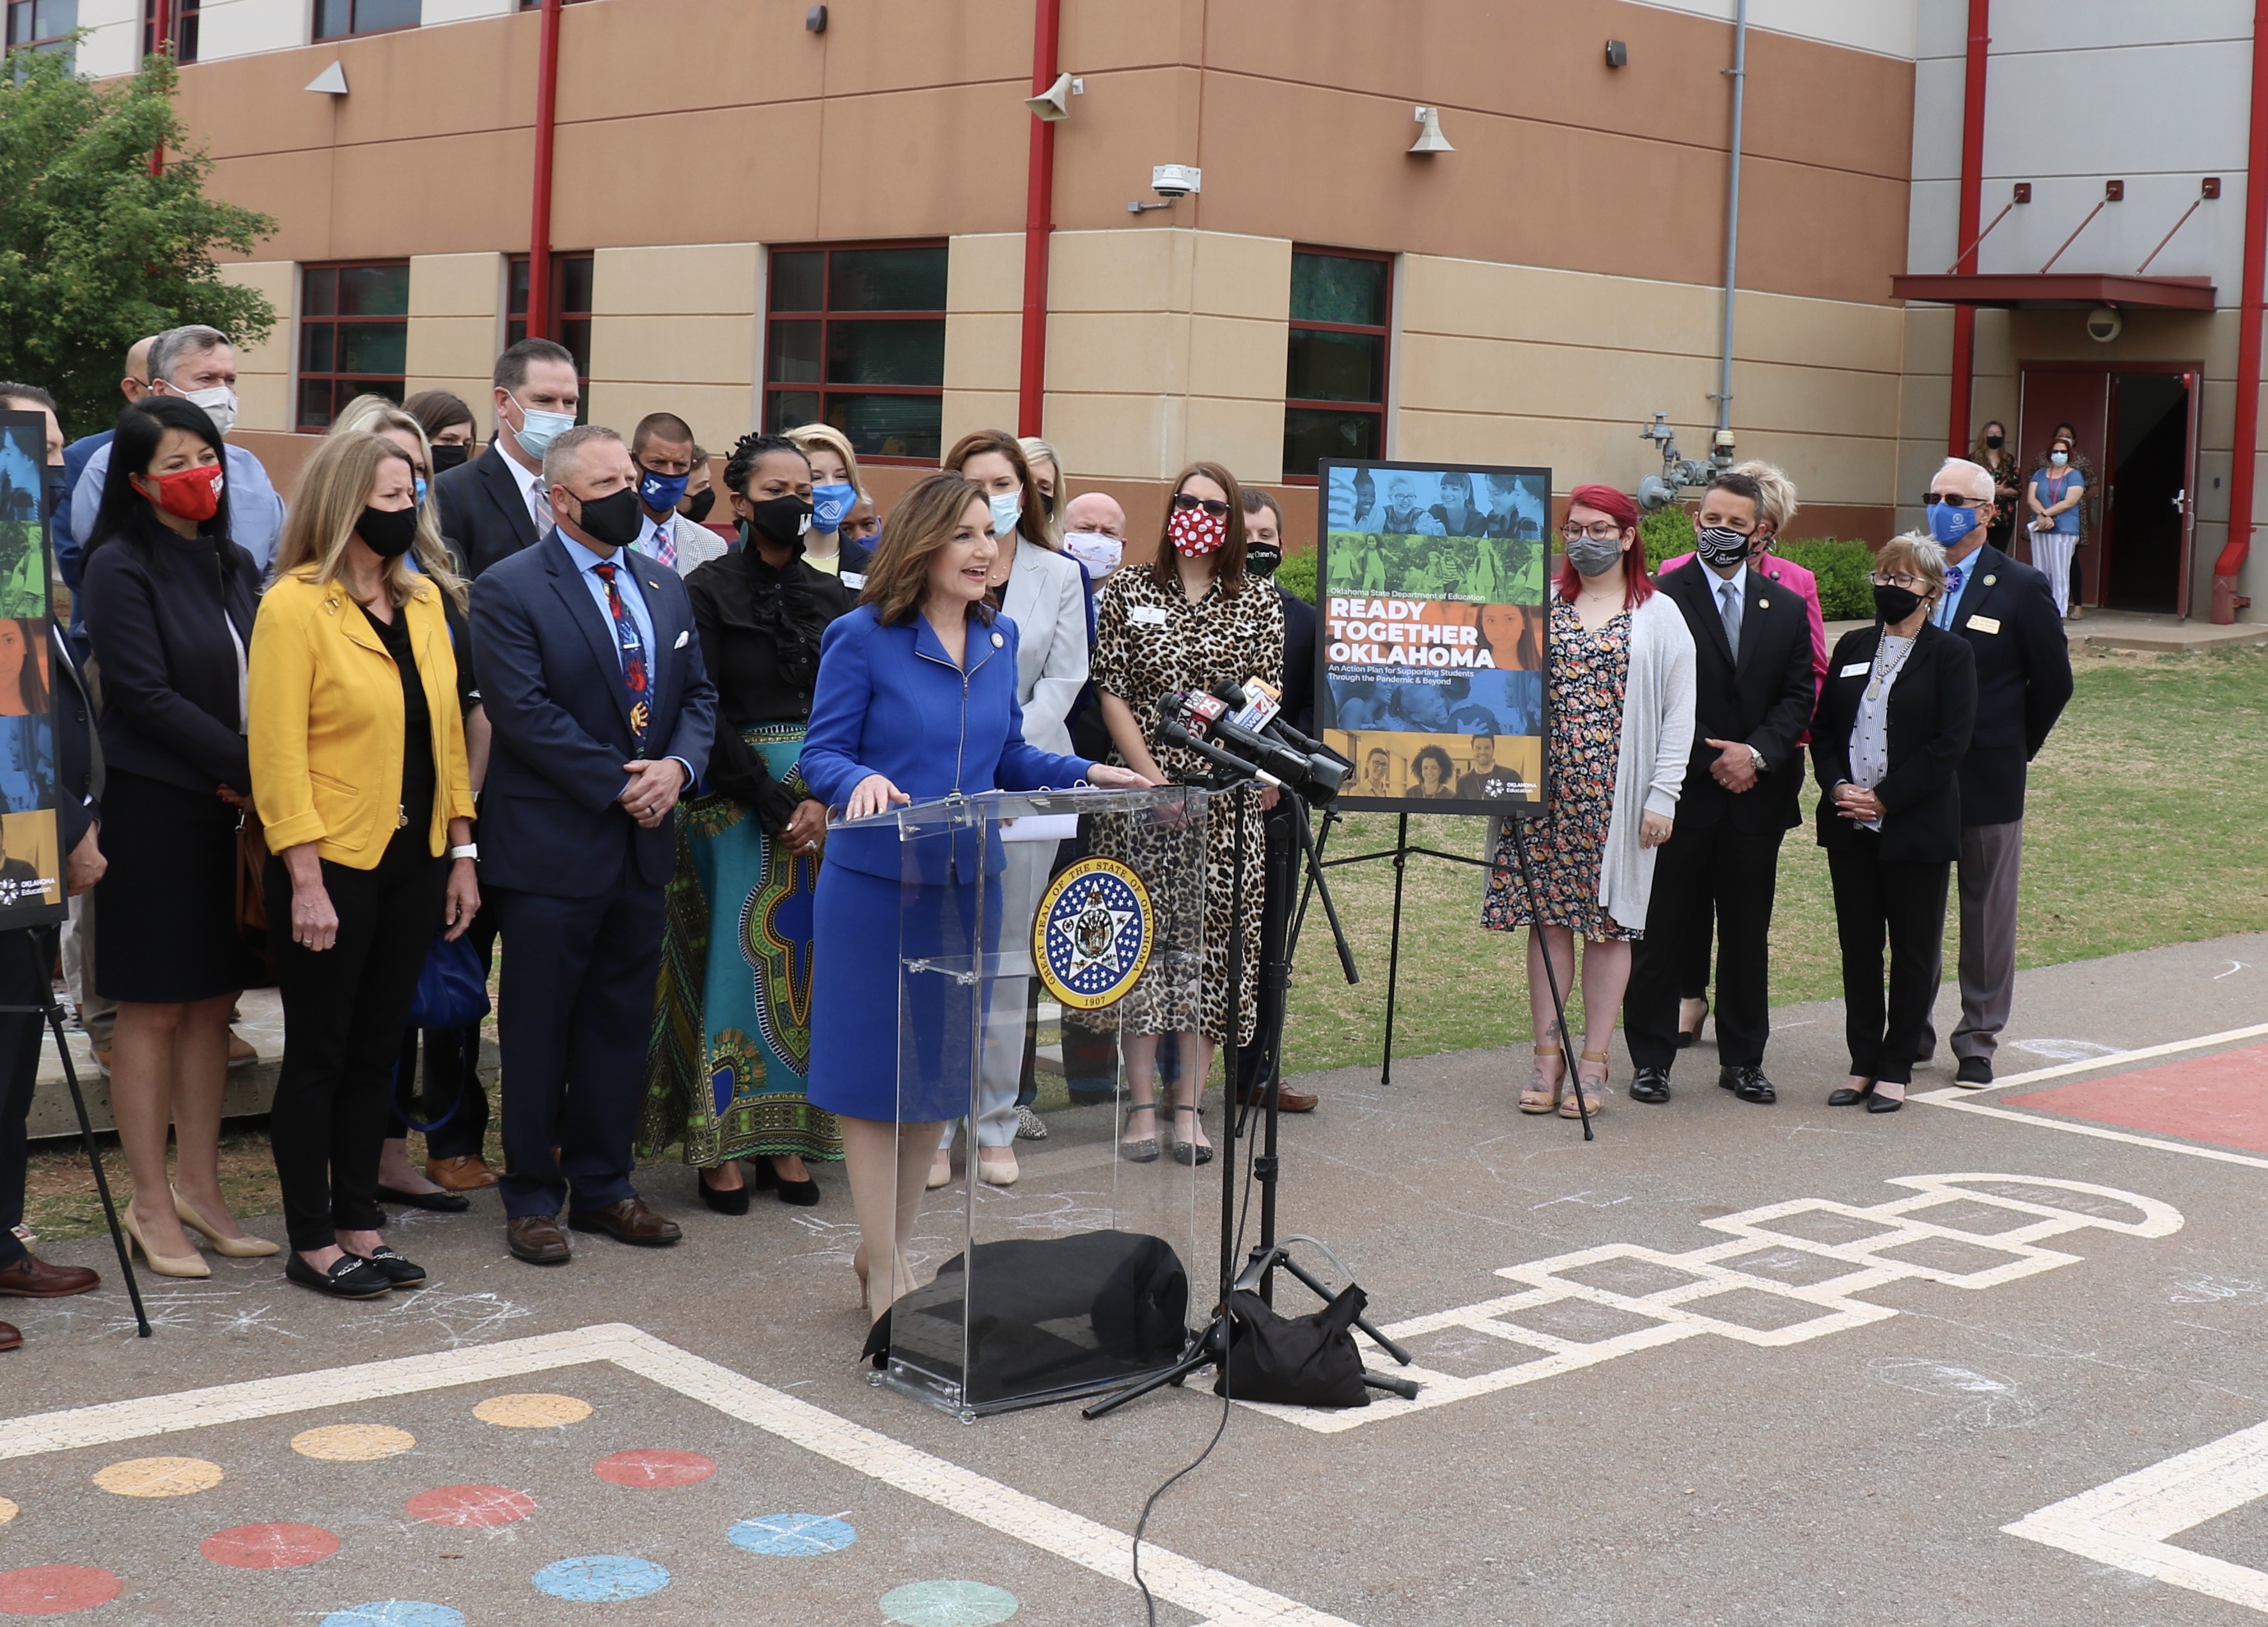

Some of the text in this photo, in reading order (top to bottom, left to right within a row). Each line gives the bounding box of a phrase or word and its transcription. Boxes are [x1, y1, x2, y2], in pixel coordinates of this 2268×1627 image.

[1331, 588, 1369, 596] Oklahoma
[1391, 590, 1437, 599] Department
[1448, 593, 1485, 601] Education
[1331, 597, 1427, 620] READY
[1329, 619, 1478, 646] TOGETHER
[1329, 642, 1496, 669] OKLAHOMA
[1328, 673, 1361, 682] Through
[1376, 675, 1414, 683] Pandemic
[1423, 677, 1451, 686] Beyond
[1385, 666, 1395, 674] for
[1397, 667, 1439, 677] Supporting
[1440, 669, 1474, 677] Students
[1199, 698, 1221, 715] 25
[1177, 712, 1191, 728] OX
[1188, 719, 1207, 740] 25
[20, 877, 56, 888] OKLAHOMA
[21, 886, 51, 896] Education
[1037, 861, 1150, 985] GREAT SEAL OF THE STATE OF OKLAHOMA
[1084, 996, 1106, 1007] 1907
